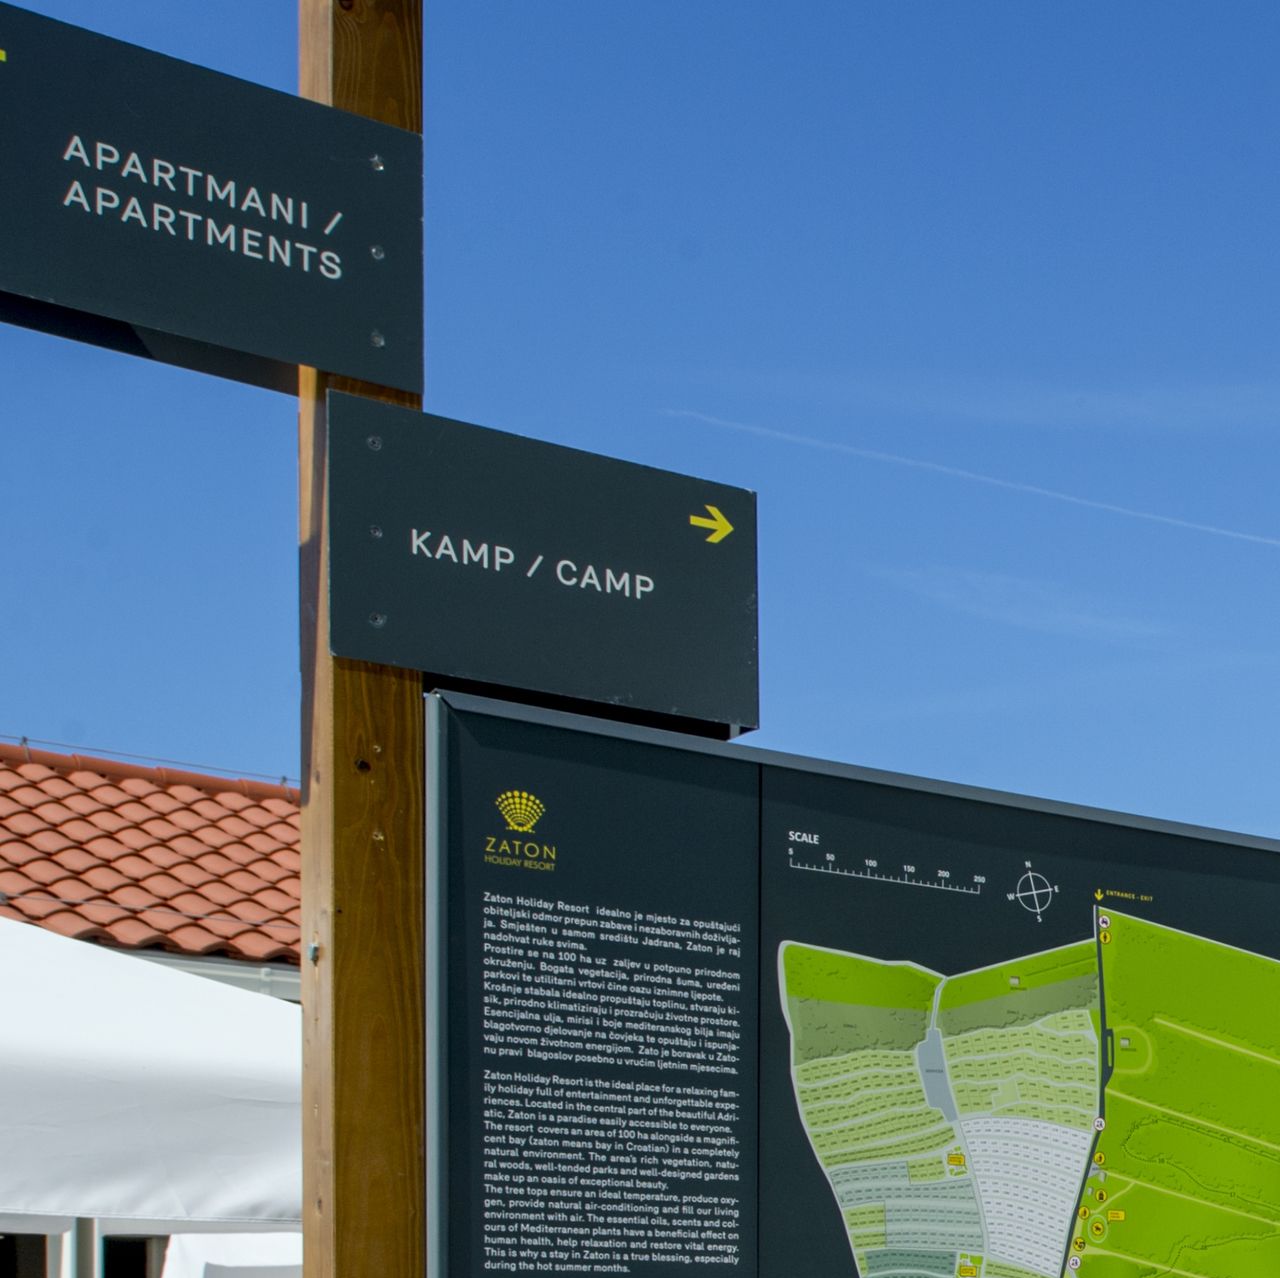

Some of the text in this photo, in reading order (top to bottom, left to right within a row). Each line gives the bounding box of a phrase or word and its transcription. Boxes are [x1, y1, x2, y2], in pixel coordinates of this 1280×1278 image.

[64, 134, 309, 228] APARTMANI
[64, 181, 342, 280] APARTMENTS
[410, 529, 515, 571] KAMP
[556, 559, 654, 599] CAMP
[485, 837, 556, 860] ZATON
[788, 831, 820, 844] SCALE
[484, 855, 555, 871] HOLIDAY RESORT
[826, 853, 835, 861] 50
[865, 859, 878, 867] 100
[903, 865, 915, 873] 150
[937, 870, 950, 878] 200
[974, 875, 986, 883] 250
[1006, 885, 1059, 901] W E
[1106, 890, 1135, 900] ENTRANCE
[1140, 894, 1153, 902] EXIT
[483, 892, 512, 904] Zaton
[516, 896, 554, 911] Holiday
[557, 901, 589, 913] Resort
[596, 906, 631, 918] idealno
[634, 910, 643, 921] je
[646, 912, 677, 926] mjesto
[693, 917, 740, 933] opuštajući
[483, 905, 530, 920] obiteljski
[532, 910, 562, 922] odmor
[564, 916, 598, 928] prepun
[599, 919, 632, 930] zabave
[638, 923, 700, 938] nezaboravnih
[1037, 915, 1042, 923] S
[500, 919, 546, 935] Smješten
[562, 929, 595, 938] samom
[599, 931, 638, 943] središtu
[686, 941, 712, 952] Zaton
[716, 945, 725, 955] je
[728, 946, 740, 957] raj
[483, 1070, 512, 1081] Zaton
[514, 1073, 551, 1085] Holiday
[552, 1075, 583, 1086] Resort
[585, 1078, 593, 1086] is
[594, 1079, 610, 1088] the
[611, 1080, 634, 1089] ideal
[635, 1082, 660, 1093] place
[661, 1084, 674, 1092] for
[682, 1085, 718, 1097] relaxing
[484, 1083, 496, 1094] ily
[498, 1084, 534, 1097] holiday
[535, 1087, 552, 1096] full
[553, 1088, 564, 1097] of
[565, 1089, 631, 1101] entertainment
[633, 1094, 650, 1103] and
[652, 1095, 713, 1109] unforgettable
[524, 1098, 563, 1109] Located
[565, 1101, 574, 1110] in
[576, 1102, 591, 1111] the
[593, 1103, 626, 1113] central
[627, 1105, 646, 1116] part
[647, 1107, 657, 1115] of
[658, 1108, 673, 1116] the
[675, 1109, 715, 1119] beautiful
